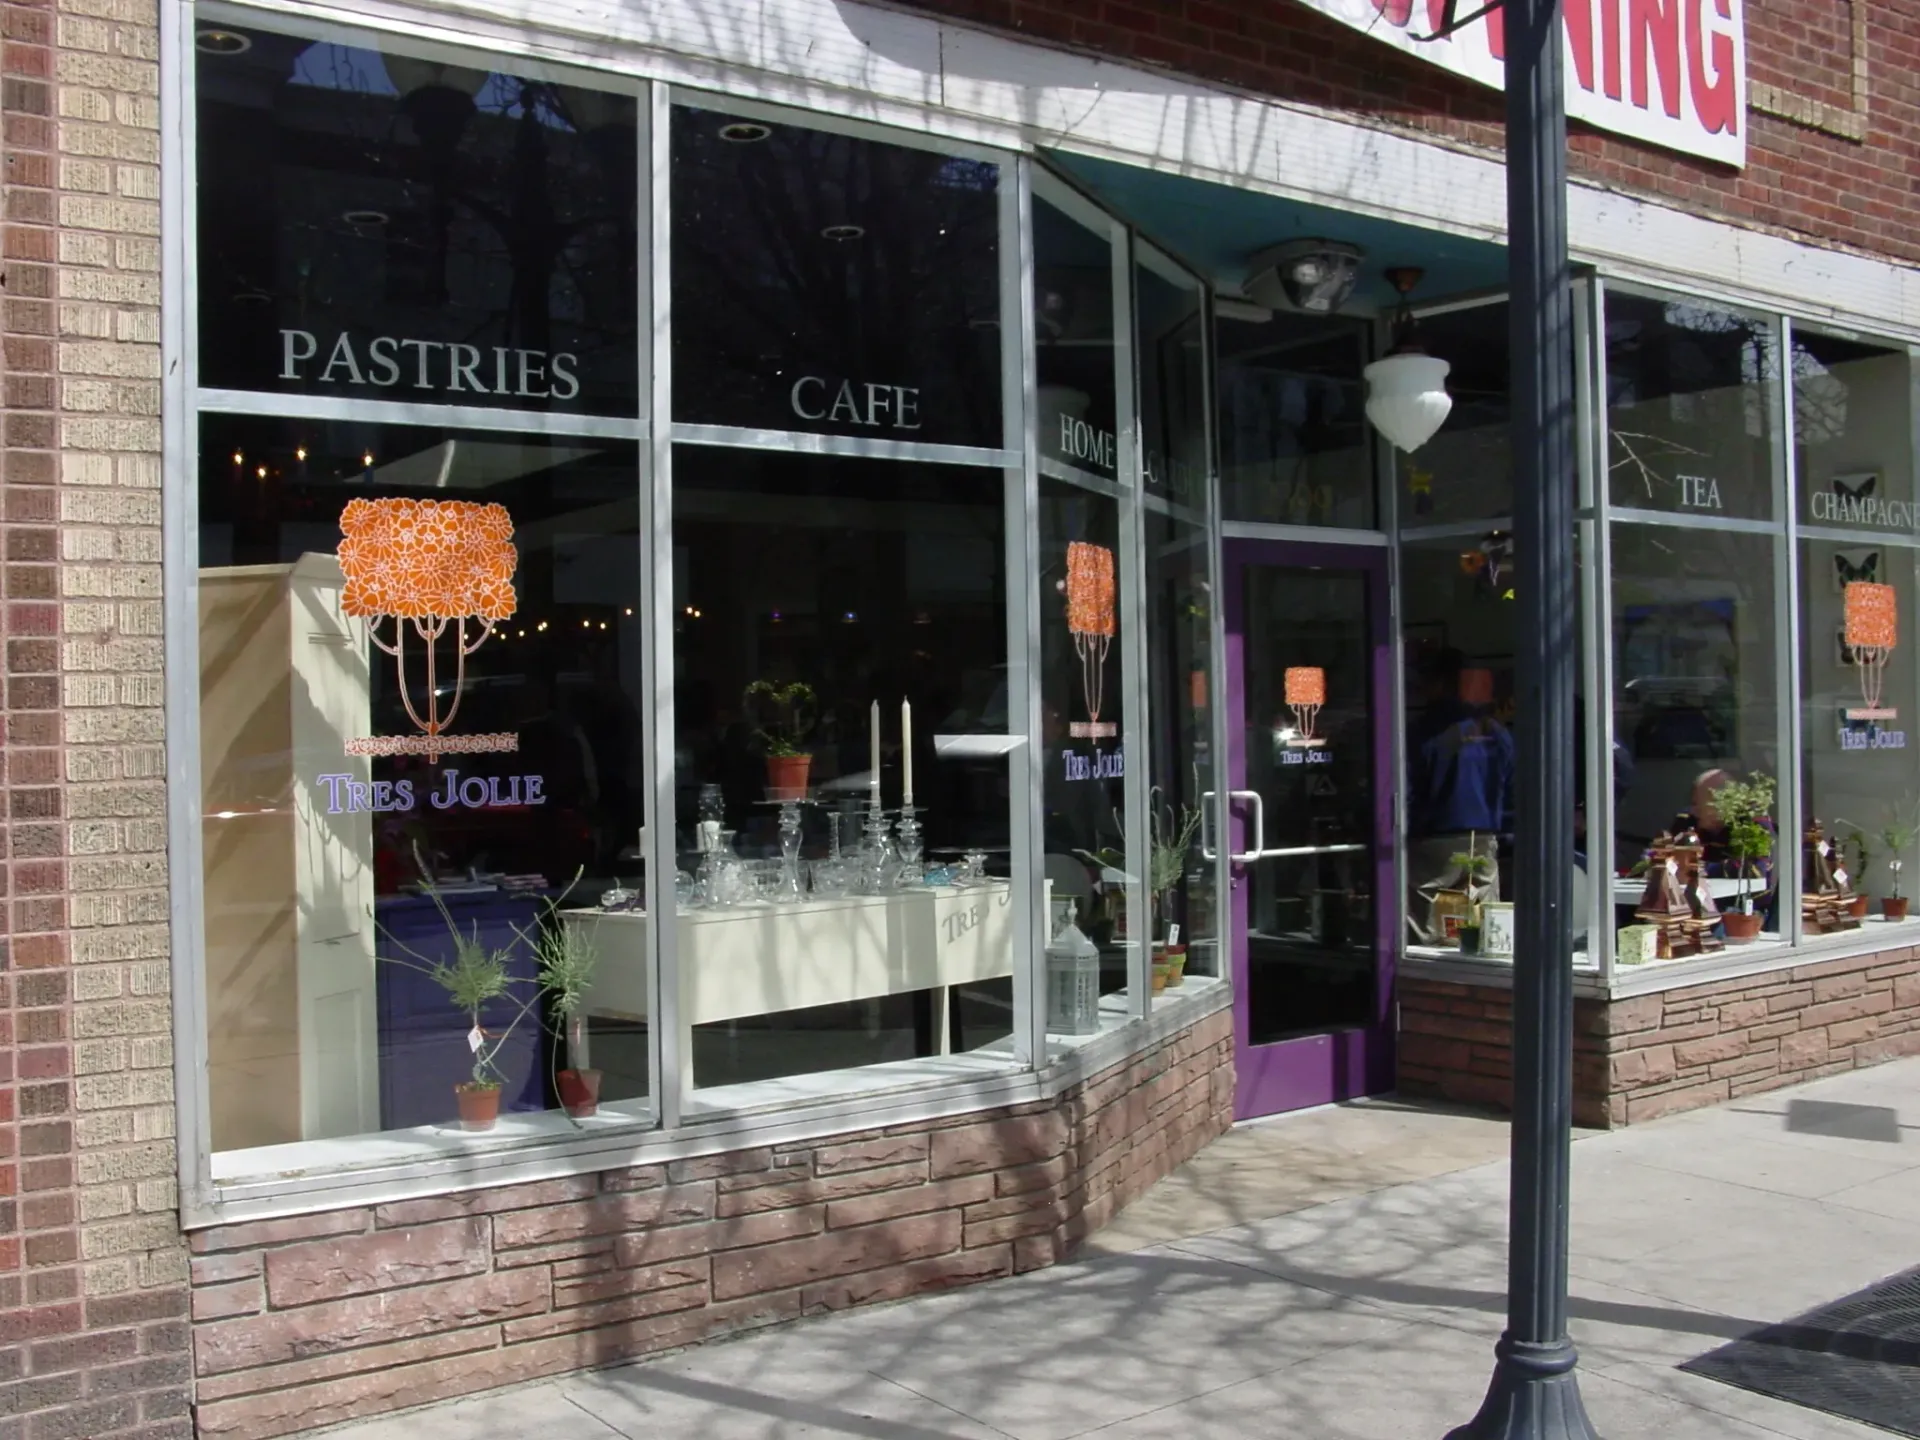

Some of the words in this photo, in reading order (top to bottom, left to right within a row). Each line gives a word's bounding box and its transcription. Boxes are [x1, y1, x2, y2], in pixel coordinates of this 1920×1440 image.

[278, 329, 580, 399] PASTRIES
[791, 376, 921, 429] CAFE
[1060, 413, 1115, 469] HOME
[1676, 474, 1722, 508] TEA
[1281, 750, 1303, 764] TRES
[1838, 727, 1867, 750] TRES
[1062, 749, 1090, 781] TRES
[316, 773, 415, 814] TRES
[431, 769, 547, 809] JOLIE
